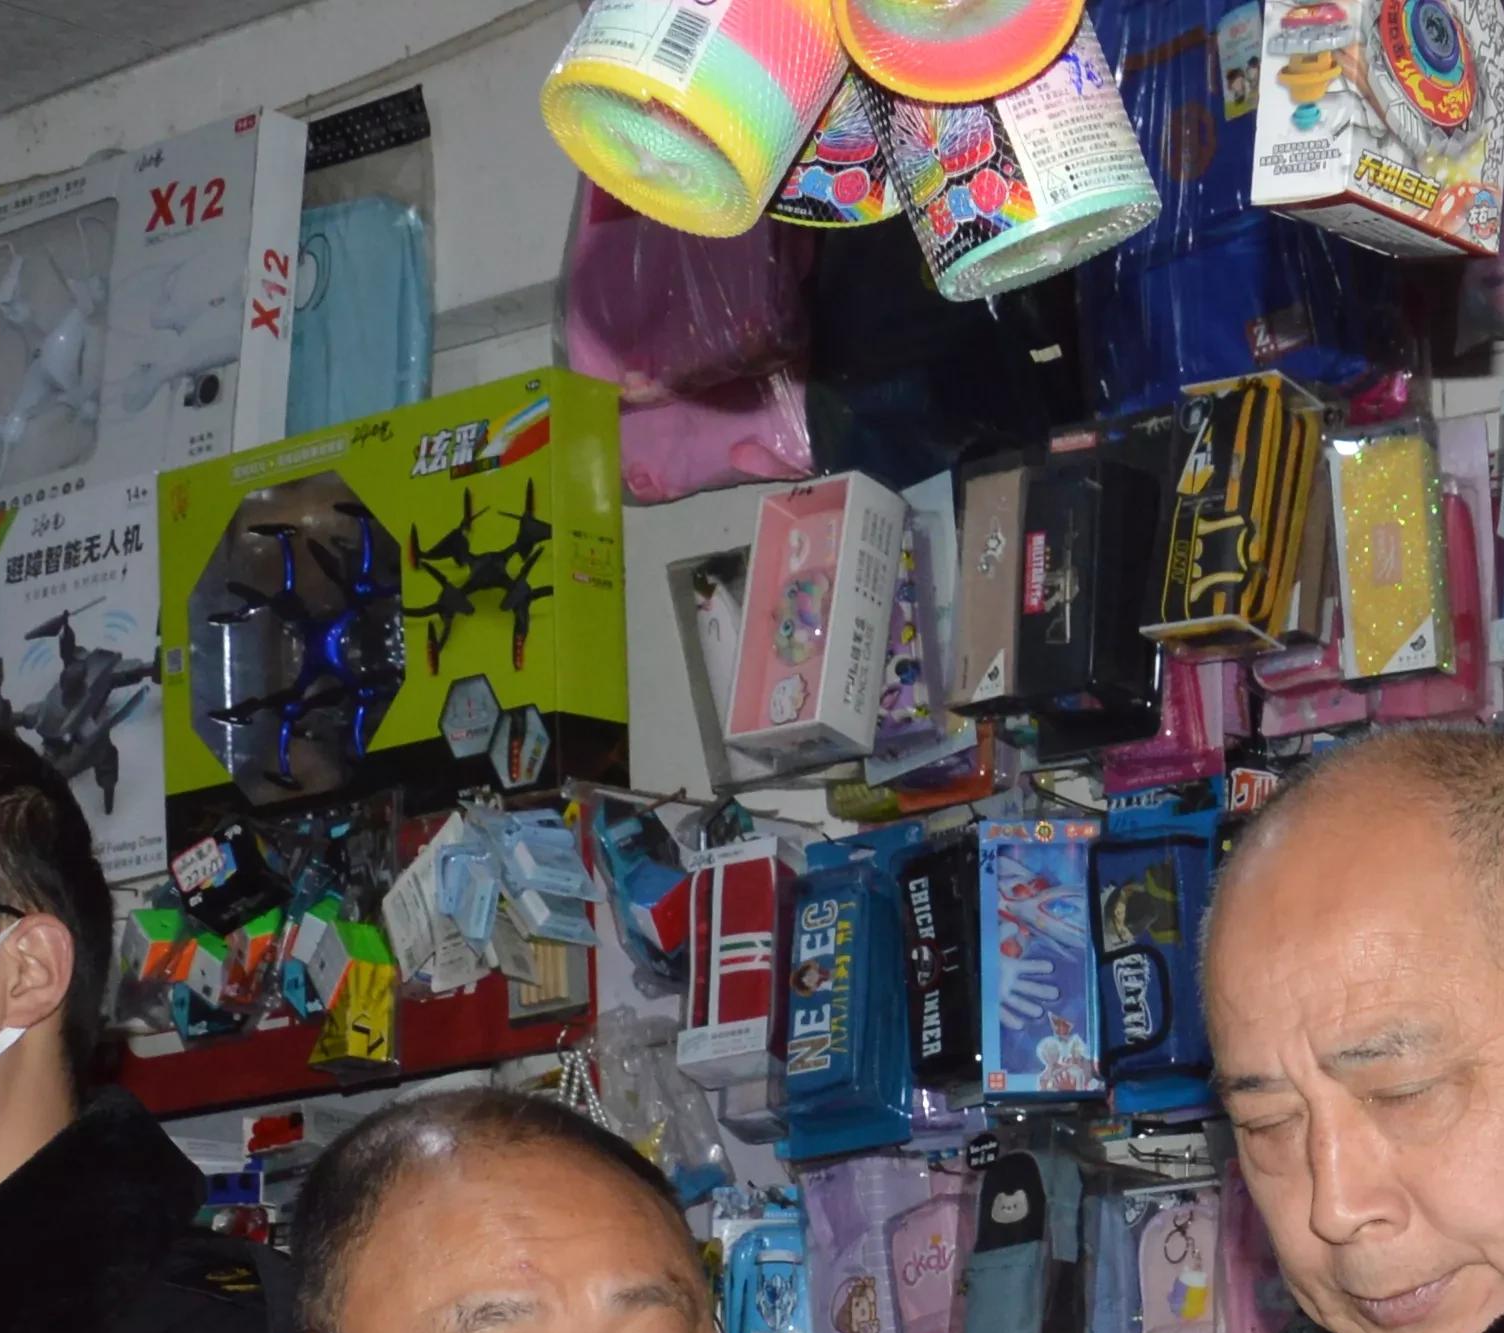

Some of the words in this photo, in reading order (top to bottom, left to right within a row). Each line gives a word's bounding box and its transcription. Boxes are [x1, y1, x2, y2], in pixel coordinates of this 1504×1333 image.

[146, 178, 226, 233] X12
[251, 249, 289, 340] X12
[410, 420, 489, 479] 炫彩
[5, 524, 144, 585] 避障智能无人机
